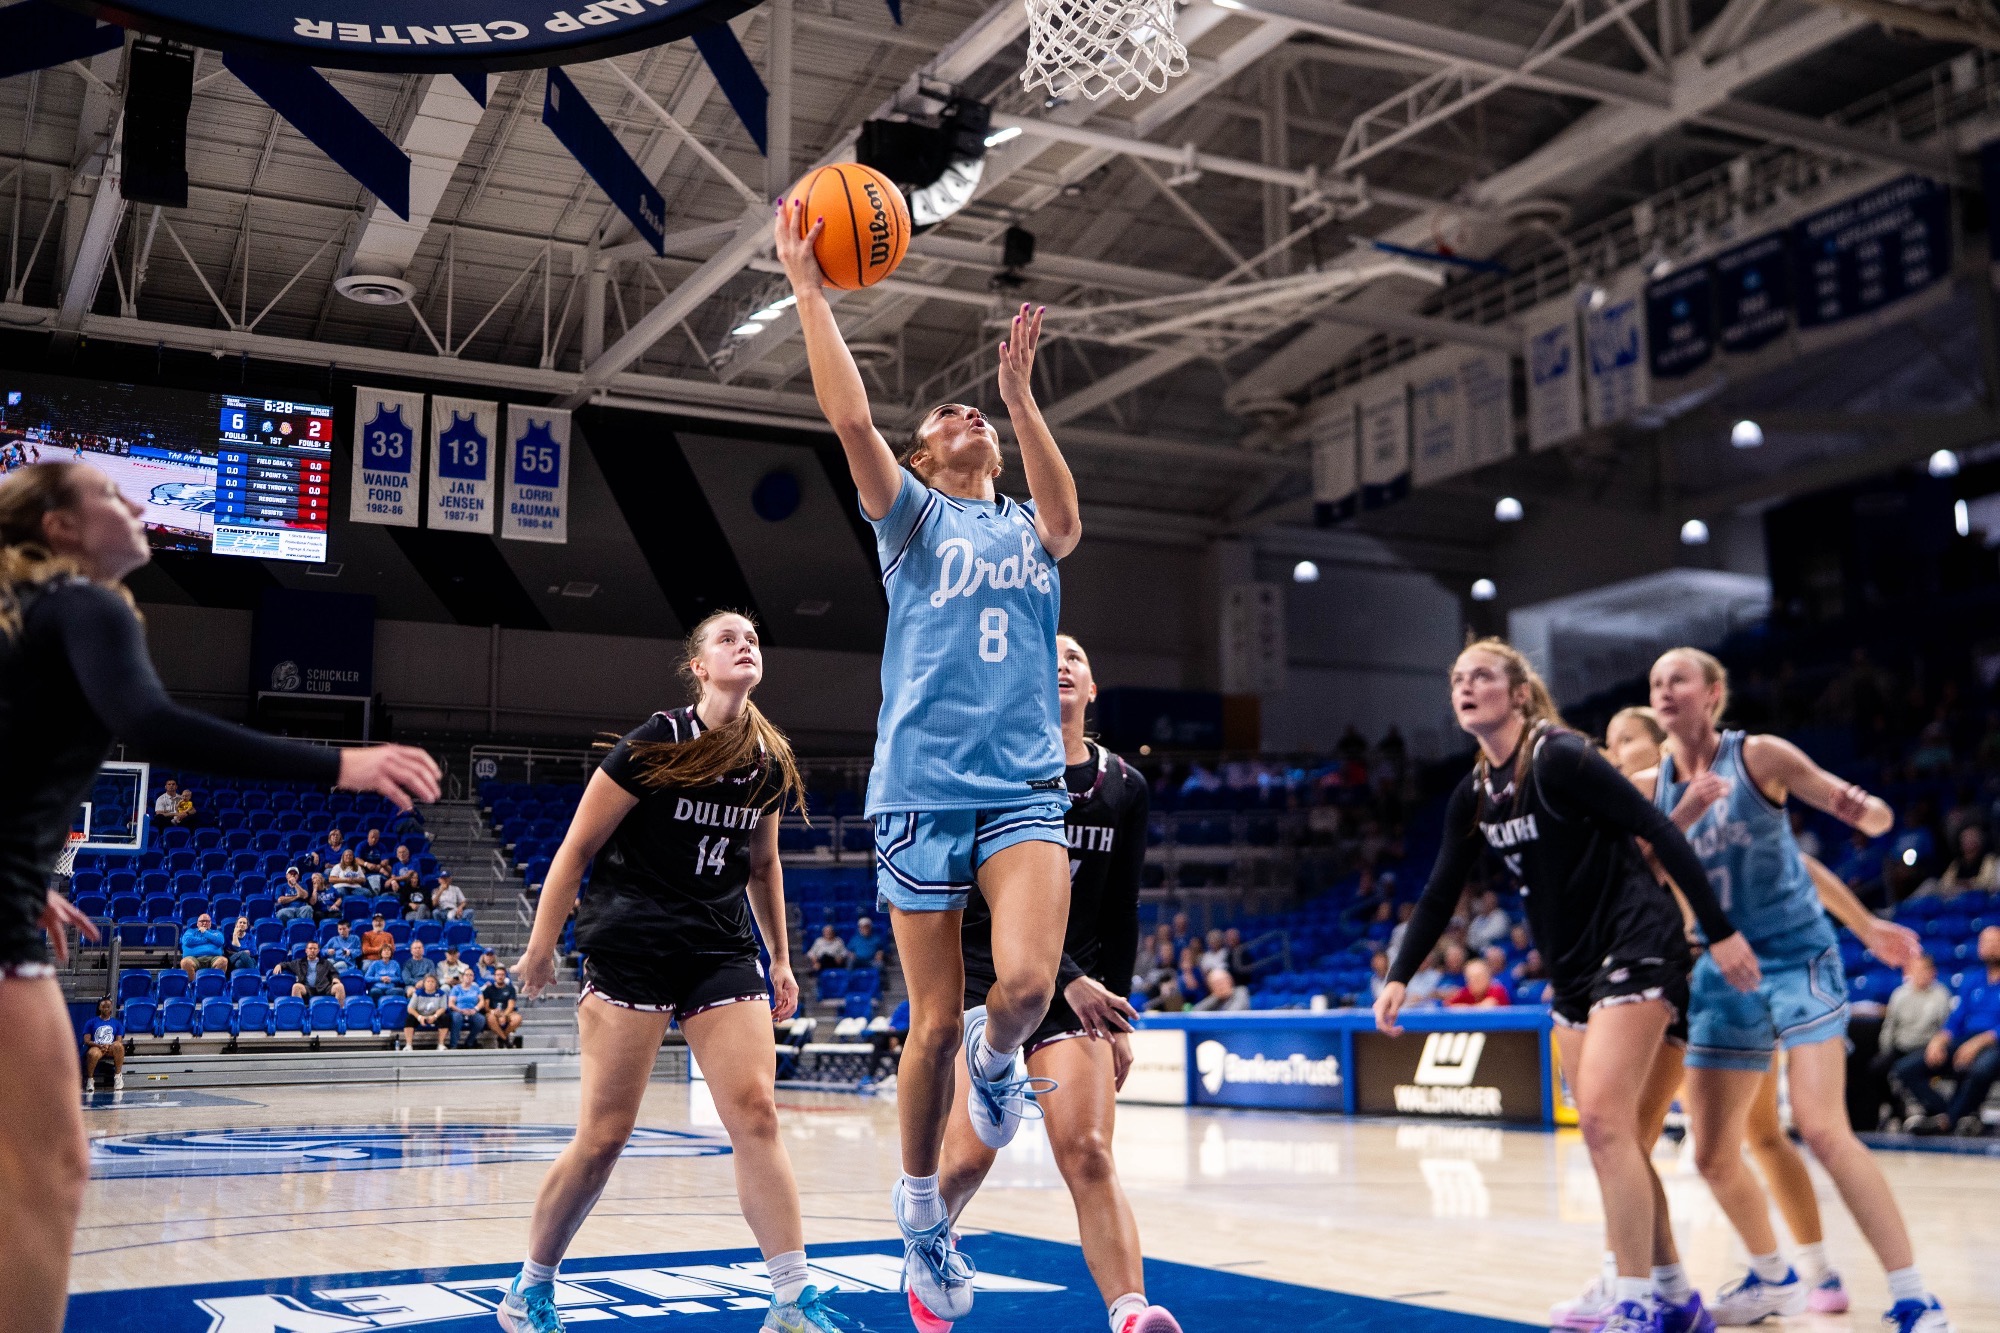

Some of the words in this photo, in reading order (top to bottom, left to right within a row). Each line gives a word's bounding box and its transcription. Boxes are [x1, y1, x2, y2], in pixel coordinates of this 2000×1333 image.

[544, 0, 668, 36] APP
[294, 17, 530, 45] CENTER
[864, 183, 890, 268] Wilson
[264, 399, 293, 414] 6:28
[232, 413, 244, 430] 6
[309, 421, 321, 437] 2
[270, 437, 283, 445] 1ST
[371, 431, 404, 459] 33
[448, 439, 479, 467] 13
[522, 446, 554, 474] 55
[363, 472, 409, 488] WANDA
[368, 489, 402, 503] FORD
[449, 482, 475, 495] JAN
[519, 488, 553, 501] LORRI
[366, 503, 403, 515] 1982-86
[439, 495, 484, 510] JENSEN
[511, 502, 560, 518] BAUMAN
[444, 511, 479, 523] 1987-91
[216, 527, 280, 537] COMPETITIVE
[930, 529, 1052, 609] Drake
[978, 607, 1009, 663] 8
[307, 668, 360, 683] SCHICKLER
[306, 680, 331, 693] CLUB
[479, 763, 495, 774] 119
[673, 796, 762, 830] DULUTH
[1067, 824, 1115, 852] UTH
[695, 835, 730, 877] 14
[1393, 1084, 1503, 1116] WALDINGER
